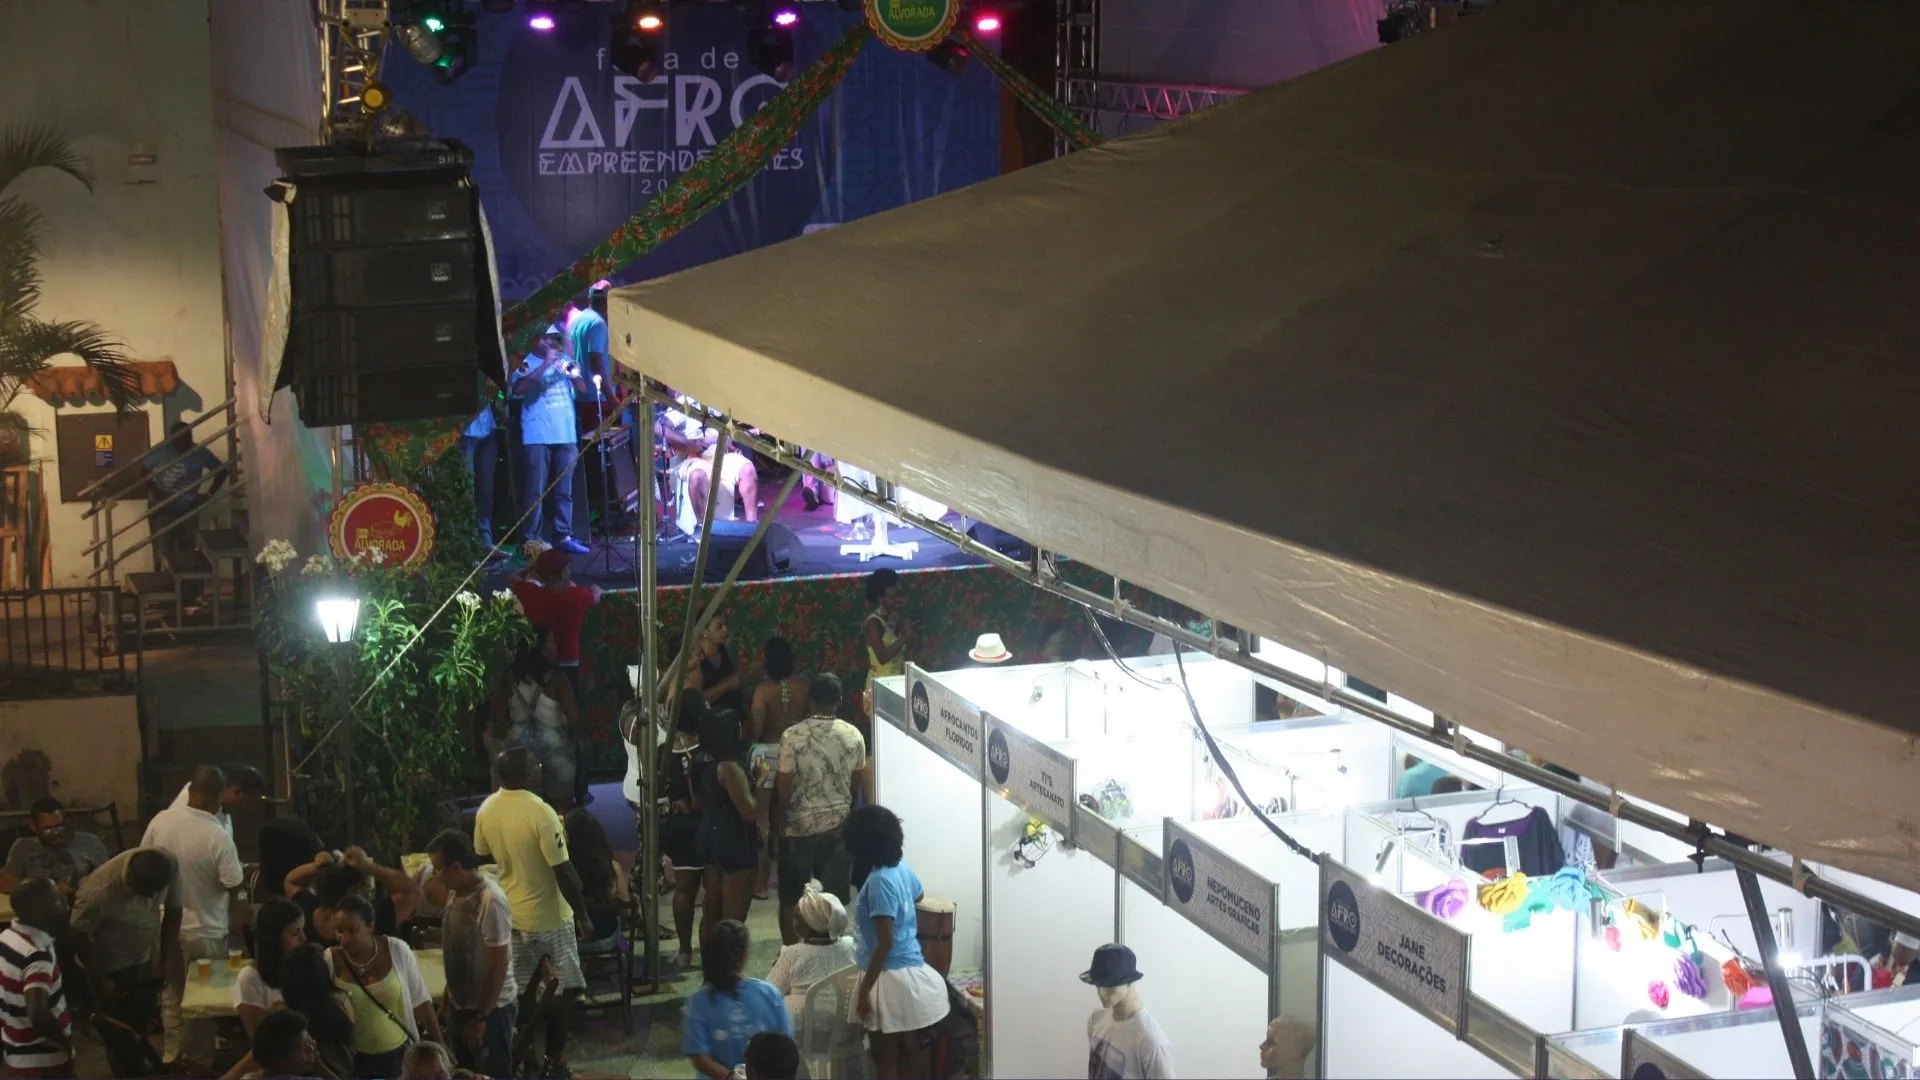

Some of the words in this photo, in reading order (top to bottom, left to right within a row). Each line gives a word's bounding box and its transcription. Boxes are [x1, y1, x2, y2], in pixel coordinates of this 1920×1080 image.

[888, 6, 936, 20] ALVORADA
[700, 46, 738, 69] de
[354, 539, 405, 552] ALVORADA
[940, 708, 979, 740] AFROCANTOS
[945, 728, 974, 753] FLORIDOS
[1029, 779, 1065, 808] ARTESANATO
[1172, 857, 1193, 881] AFRO
[1207, 876, 1261, 921] NEPOMUCENO
[1207, 893, 1227, 913] ARTES
[1331, 901, 1357, 929] AFRO
[1399, 934, 1426, 961] JANE
[1377, 941, 1446, 993] DECORAÇÕES
